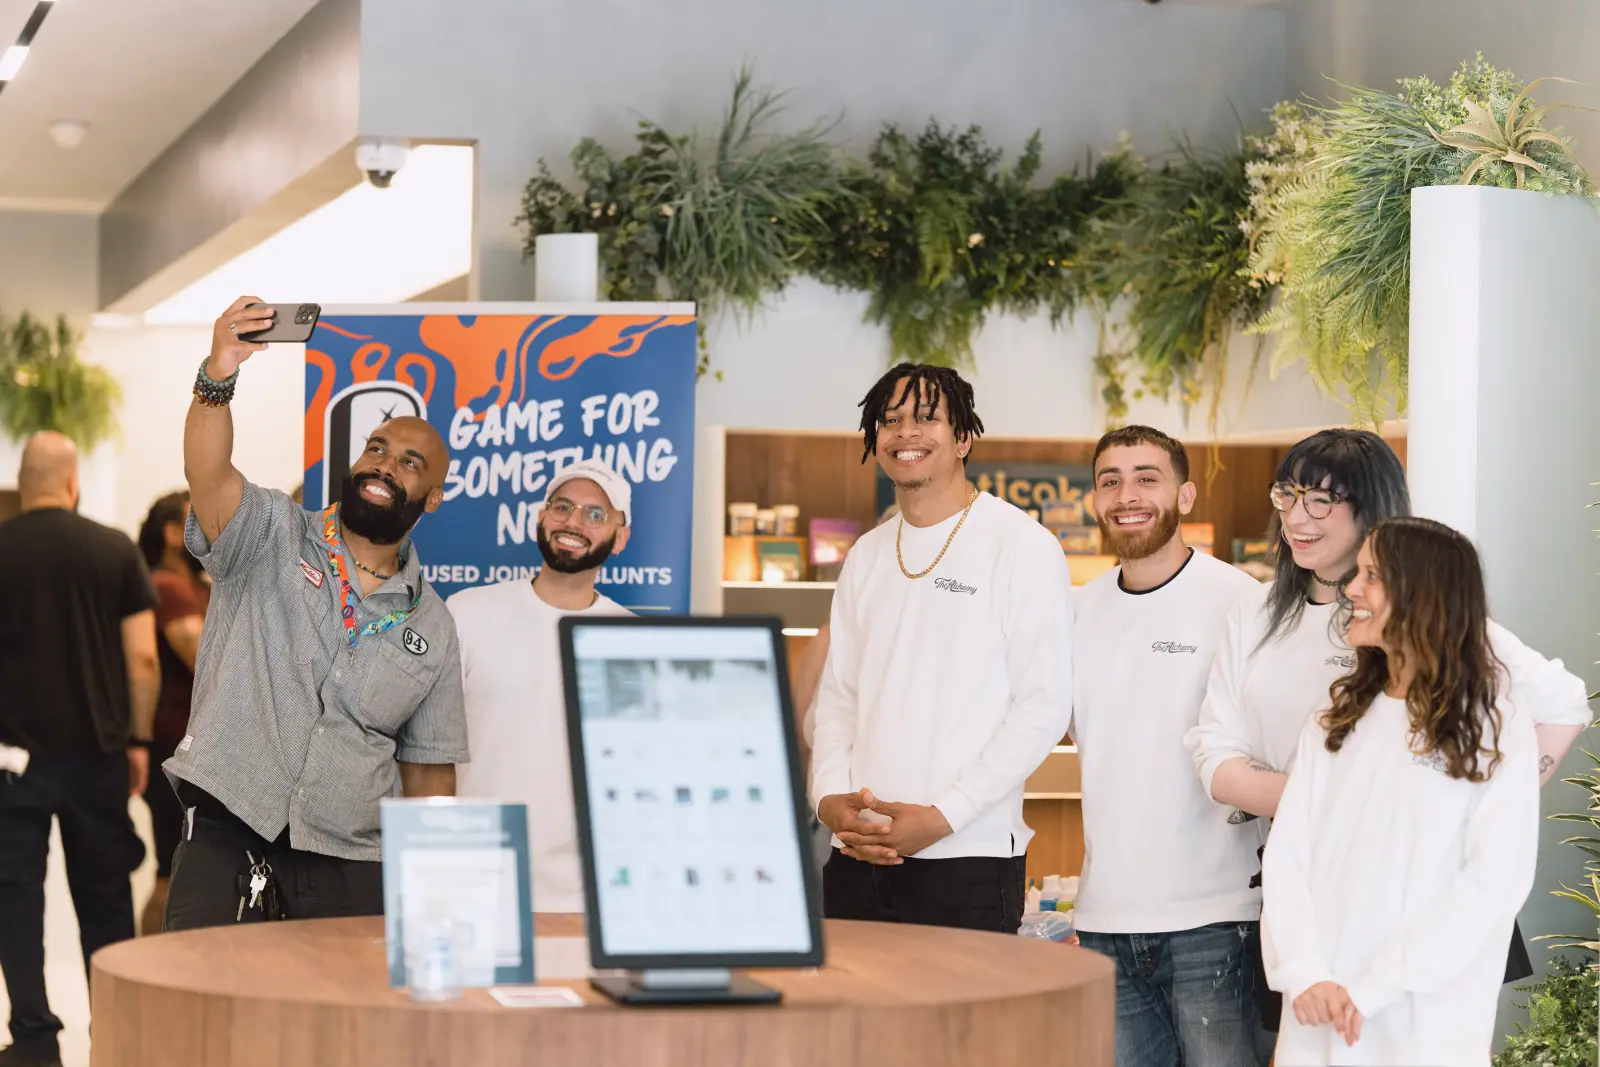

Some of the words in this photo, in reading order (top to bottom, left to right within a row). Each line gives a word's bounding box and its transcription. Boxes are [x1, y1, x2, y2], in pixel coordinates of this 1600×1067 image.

[449, 398, 563, 450] GAME
[581, 389, 660, 437] FOR
[442, 438, 678, 501] SOMETHING
[420, 565, 480, 583] USED
[484, 566, 542, 583] JOIN
[946, 579, 978, 596] Alchemy
[405, 631, 423, 652] 94
[1163, 641, 1198, 655] Alchemy
